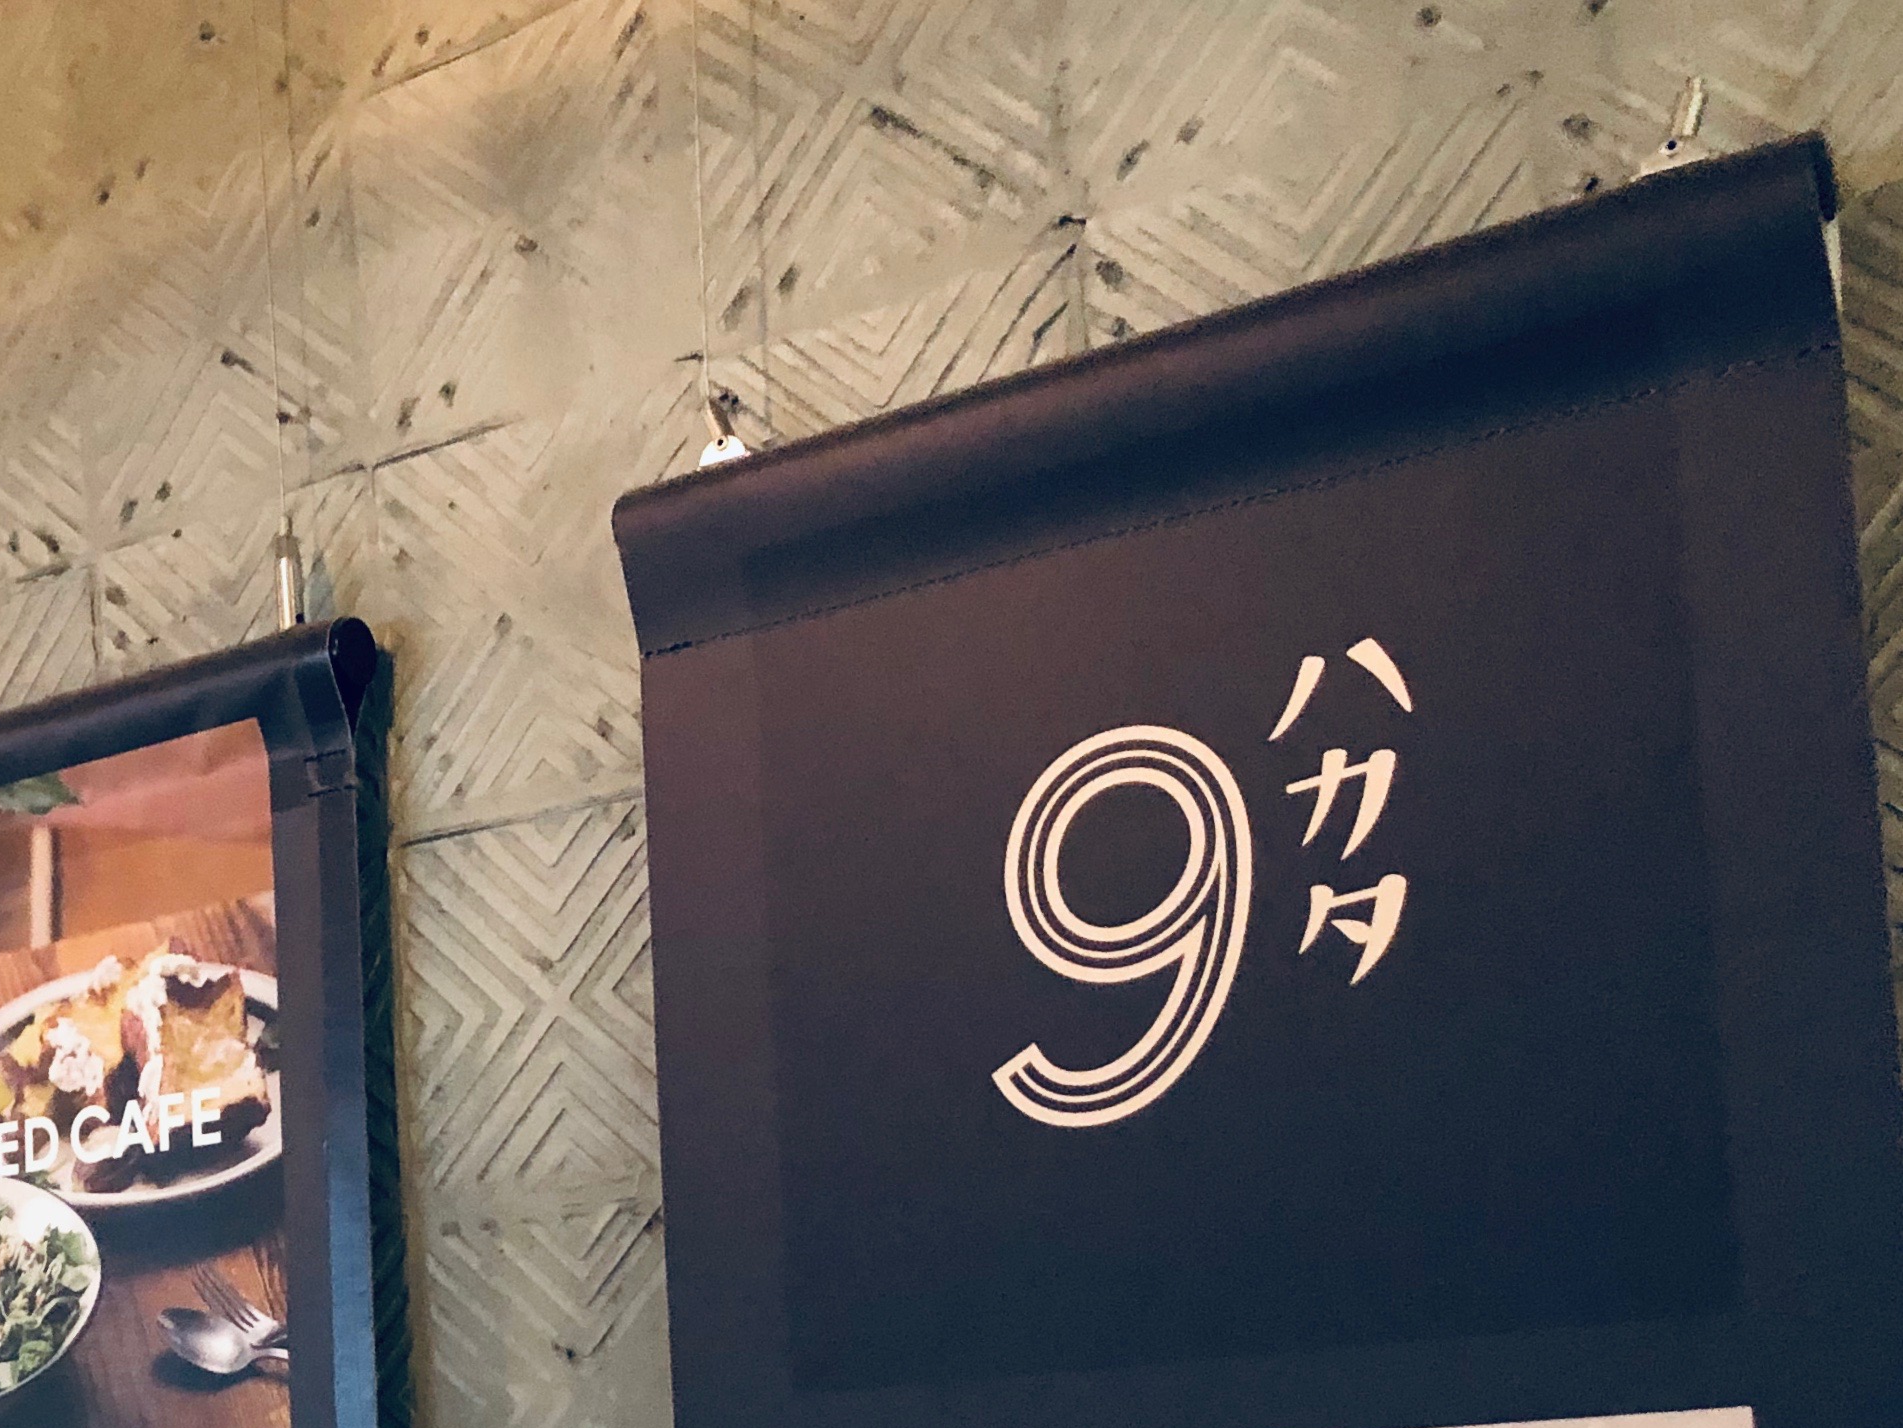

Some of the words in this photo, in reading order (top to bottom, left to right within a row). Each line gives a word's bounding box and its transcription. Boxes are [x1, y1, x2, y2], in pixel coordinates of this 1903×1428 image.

[1268, 637, 1413, 985] ハカタ
[70, 1087, 223, 1165] CAFE
